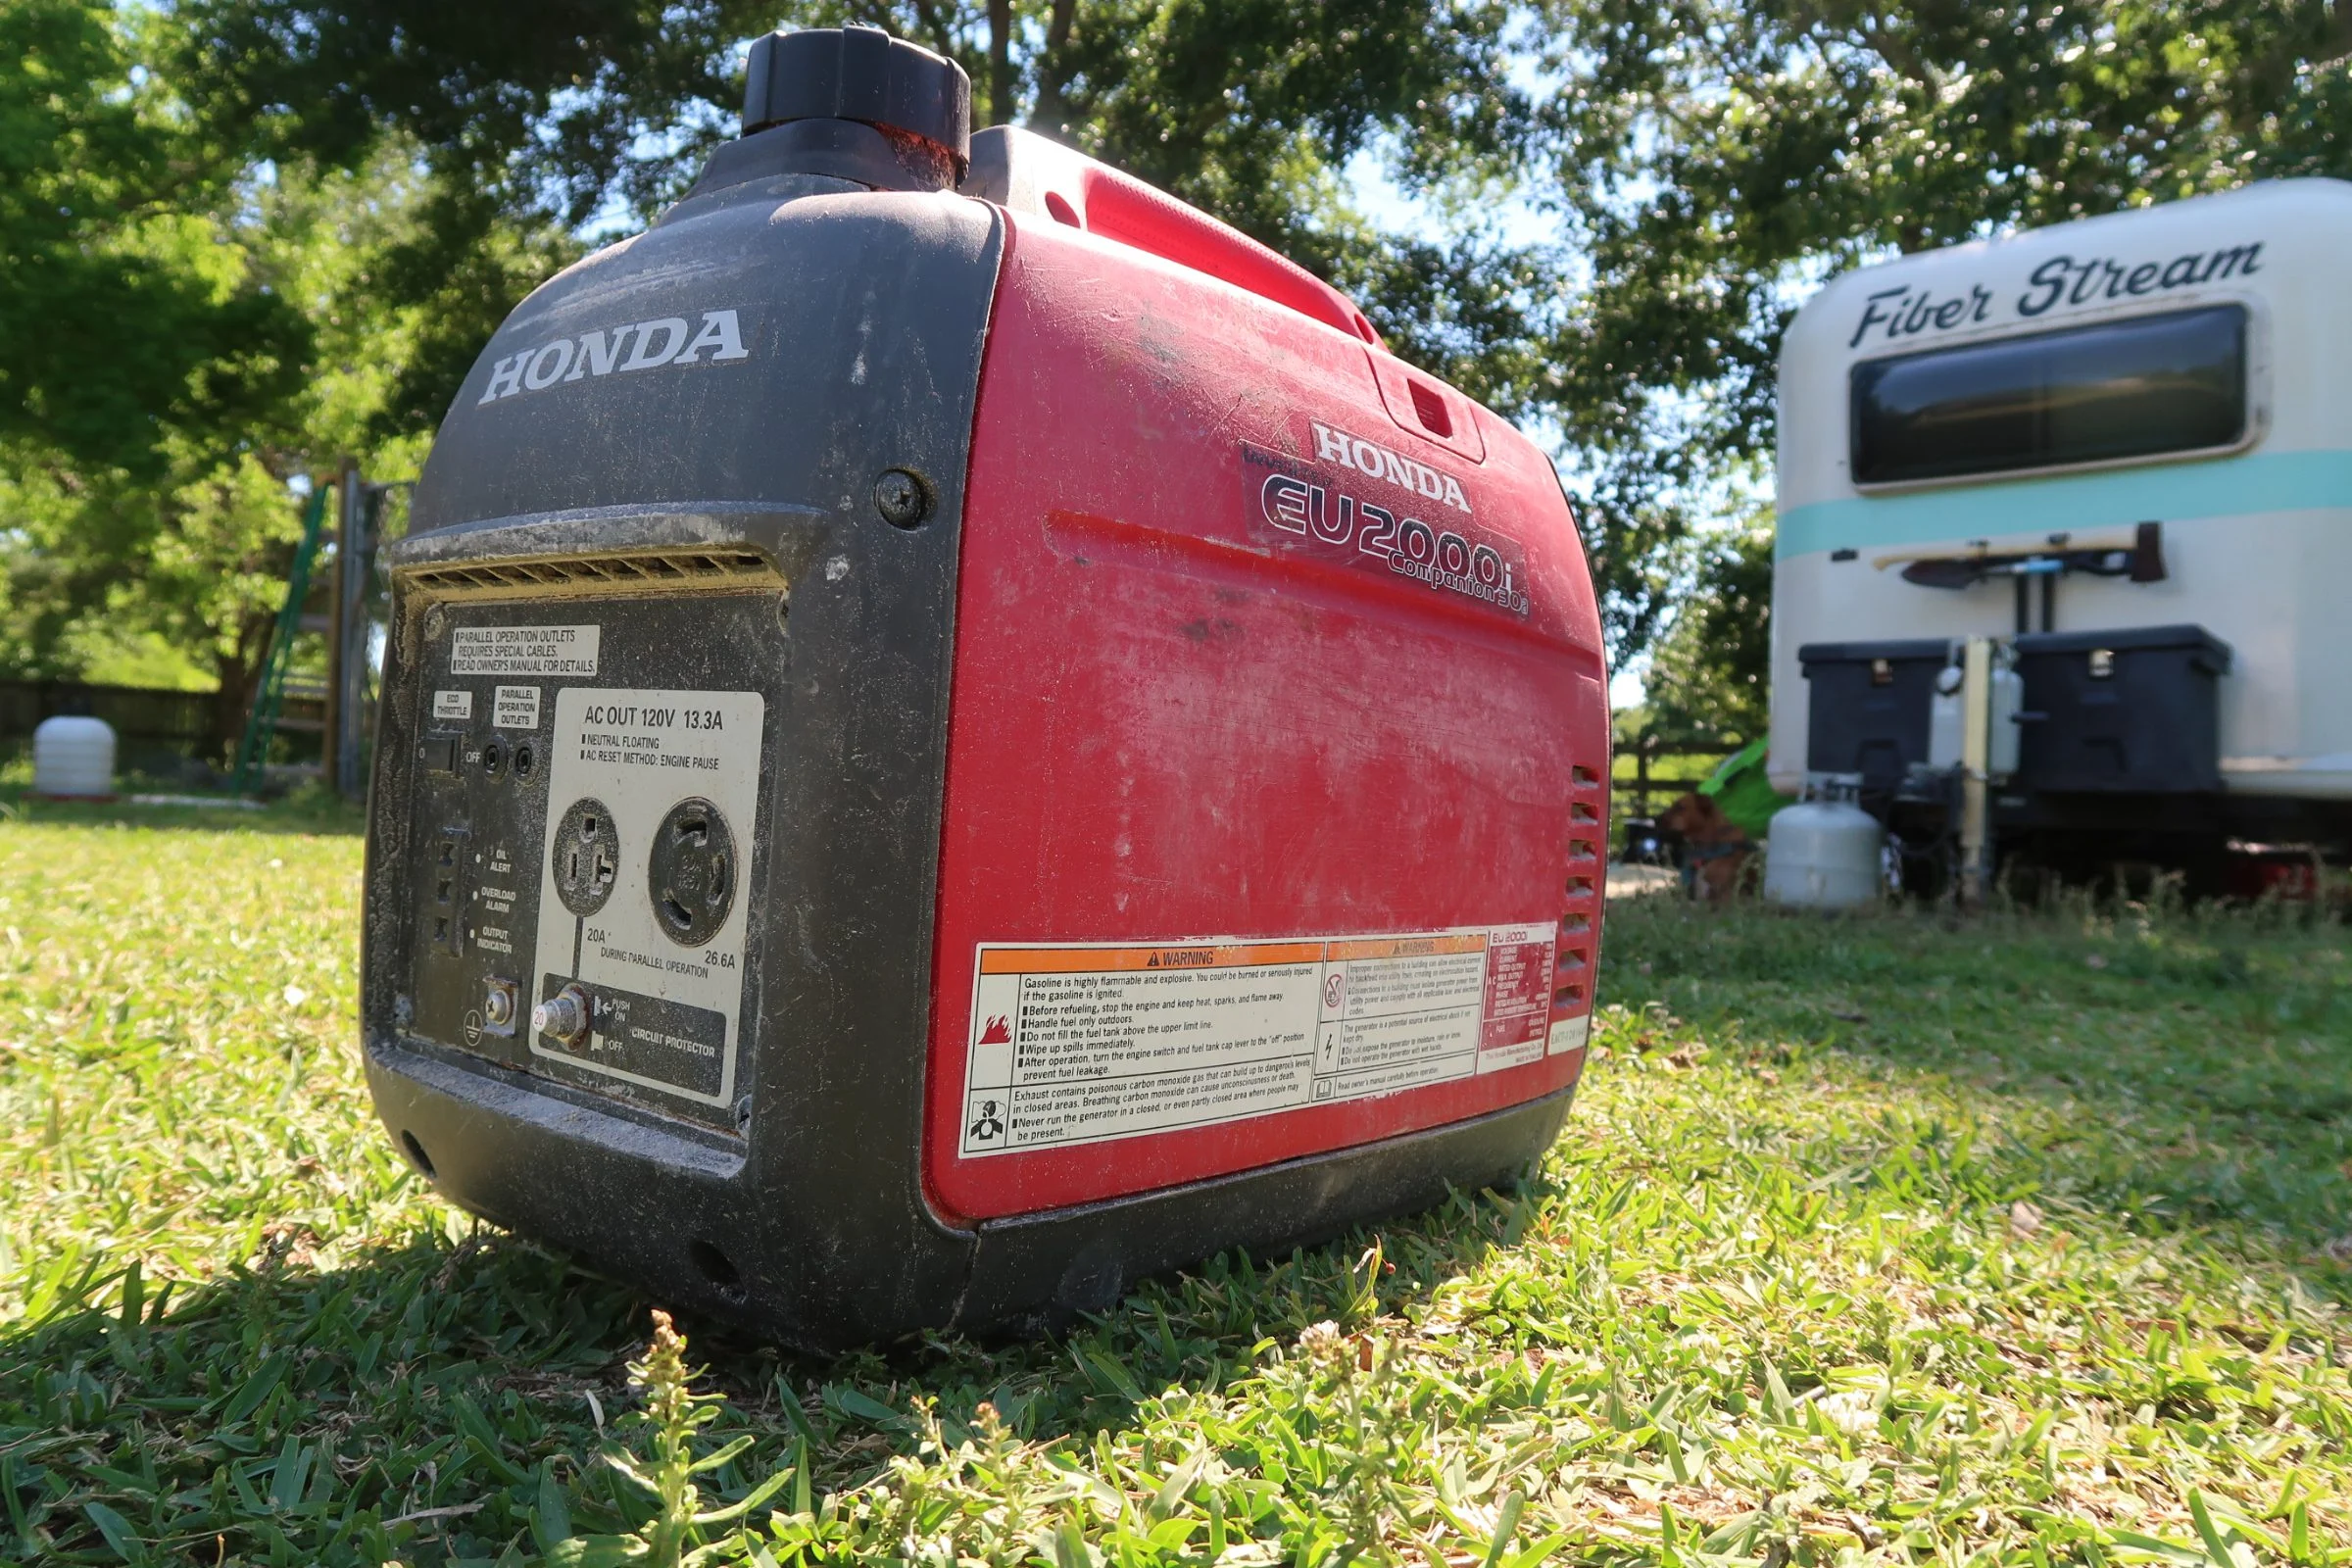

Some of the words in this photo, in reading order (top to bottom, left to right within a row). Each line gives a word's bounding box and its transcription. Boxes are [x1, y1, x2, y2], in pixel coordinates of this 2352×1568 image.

[1849, 282, 1995, 349] Fiber
[2016, 239, 2266, 318] Stream
[478, 310, 749, 406] HONDA
[1312, 422, 1472, 514] HONDA
[1388, 549, 1495, 602] Companion
[460, 631, 493, 643] PARALLEL
[496, 630, 538, 643] OPERATION
[540, 630, 575, 642] OUTLETS
[459, 646, 493, 659] REQUIRES
[495, 646, 524, 657] SPECIAL
[527, 646, 558, 657] CABLES.
[457, 661, 475, 670] READ
[477, 661, 509, 671] OWNER'S
[510, 661, 541, 671] MANUAL
[544, 661, 559, 671] FOR
[561, 661, 595, 672] DETAILS.
[502, 690, 533, 699] PARALLEL
[437, 705, 466, 716] THROTTLE
[498, 703, 535, 712] OPERATION
[502, 715, 529, 725] OUTLETS
[585, 706, 603, 724] AC
[608, 707, 637, 726] OUT
[642, 709, 675, 727] 120V
[684, 710, 723, 729] 13.3A
[588, 735, 619, 747] NEUTRAL
[622, 736, 659, 749] FLOATING
[466, 752, 481, 762] OFF
[586, 751, 596, 760] AC
[598, 751, 621, 762] RESET
[623, 753, 658, 765] METHOD:
[661, 755, 690, 767] ENGINE
[693, 758, 718, 770] PAUSE
[496, 850, 507, 859] OIL
[490, 862, 512, 872] ALERT
[481, 887, 515, 901] OVERLOAD
[486, 901, 510, 913] ALARM
[482, 927, 509, 939] OUTPUT
[477, 938, 513, 954] INDICATOR
[587, 928, 605, 943] 20A
[705, 951, 735, 968] 26.6A
[601, 947, 626, 961] DURING
[628, 953, 663, 969] PARALLEL
[666, 959, 708, 978] OPERATION
[1162, 952, 1213, 966] WARNING
[1025, 978, 1061, 988] Gasoline
[1065, 978, 1070, 987] is
[1074, 977, 1098, 988] highly
[1101, 975, 1142, 986] flammable
[1144, 975, 1157, 984] and
[1160, 973, 1194, 985] explosive.
[1229, 971, 1237, 980] be
[1239, 969, 1258, 979] burned
[1023, 991, 1030, 1001] if
[1032, 991, 1046, 1001] the
[1049, 990, 1084, 1002] gasoline
[1086, 990, 1093, 999] is
[612, 1000, 631, 1011] PUSH
[1030, 1005, 1057, 1016] Before
[1060, 1004, 1100, 1015] refueling,
[1102, 1004, 1118, 1015] stop
[1121, 1003, 1133, 1011] the
[1136, 1001, 1159, 1010] engine
[1162, 1000, 1175, 1008] and
[1178, 999, 1195, 1008] keep
[1197, 997, 1212, 1006] heat,
[1251, 993, 1267, 1002] flame
[533, 1009, 544, 1026] 20
[615, 1011, 626, 1021] ON
[1028, 1018, 1058, 1028] Handle
[1060, 1017, 1076, 1026] fuel
[1079, 1016, 1096, 1027] only
[1098, 1015, 1134, 1025] outdoors.
[1027, 1032, 1039, 1042] Do
[1042, 1031, 1055, 1041] not
[1058, 1030, 1068, 1040] fill
[1071, 1029, 1084, 1039] the
[1086, 1028, 1101, 1038] fuel
[1103, 1028, 1120, 1037] tank
[1123, 1025, 1146, 1035] above
[1148, 1024, 1158, 1033] the
[1161, 1023, 1182, 1033] upper
[1184, 1021, 1199, 1030] limit
[608, 1040, 623, 1051] OFF
[631, 1029, 663, 1045] CIRCUIT
[664, 1035, 715, 1057] PROTECTOR
[1024, 1057, 1046, 1067] After
[1094, 1054, 1109, 1062] turn
[1111, 1053, 1124, 1061] the
[1126, 1050, 1152, 1060] engine
[1152, 1046, 1175, 1056] switch
[1177, 1045, 1190, 1054] and
[1192, 1043, 1204, 1052] fuel
[1205, 1042, 1219, 1051] tank
[1221, 1042, 1233, 1051] cap
[1234, 1039, 1249, 1048] lever
[1250, 1038, 1256, 1047] to
[1283, 1033, 1304, 1043] position
[1025, 1045, 1048, 1054] Wipe
[1050, 1045, 1060, 1054] up
[1063, 1042, 1084, 1054] spills
[1086, 1040, 1135, 1051] immediately.
[1023, 1069, 1055, 1082] prevent
[1058, 1068, 1074, 1078] fuel
[1076, 1064, 1110, 1077] leakage.
[1014, 1091, 1049, 1102] Exhaust
[1052, 1088, 1086, 1098] contains
[1088, 1083, 1127, 1096] poisonous
[1129, 1079, 1154, 1089] carbon
[1157, 1073, 1191, 1086] monoxide
[1193, 1074, 1204, 1084] gas
[1206, 1072, 1218, 1082] that
[1233, 1067, 1248, 1077] build
[1013, 1104, 1021, 1114] in
[1024, 1102, 1052, 1112] closed
[1054, 1100, 1080, 1109] areas.
[1083, 1095, 1120, 1106] Breathing
[1123, 1091, 1149, 1102] carbon
[1152, 1088, 1185, 1100] monoxide
[1200, 1084, 1219, 1093] cause
[1018, 1117, 1045, 1128] Never
[1047, 1115, 1061, 1124] run
[1064, 1113, 1077, 1123] the
[1079, 1110, 1118, 1123] generator
[1120, 1105, 1127, 1116] in
[1136, 1102, 1161, 1114] closed,
[1173, 1100, 1190, 1109] even
[1192, 1096, 1210, 1107] partly
[1212, 1093, 1232, 1103] closed
[1234, 1092, 1248, 1101] area
[1249, 1088, 1266, 1098] where
[1267, 1085, 1286, 1098] people
[1287, 1083, 1299, 1093] may
[1017, 1131, 1028, 1142] be
[1031, 1128, 1065, 1142] present.
